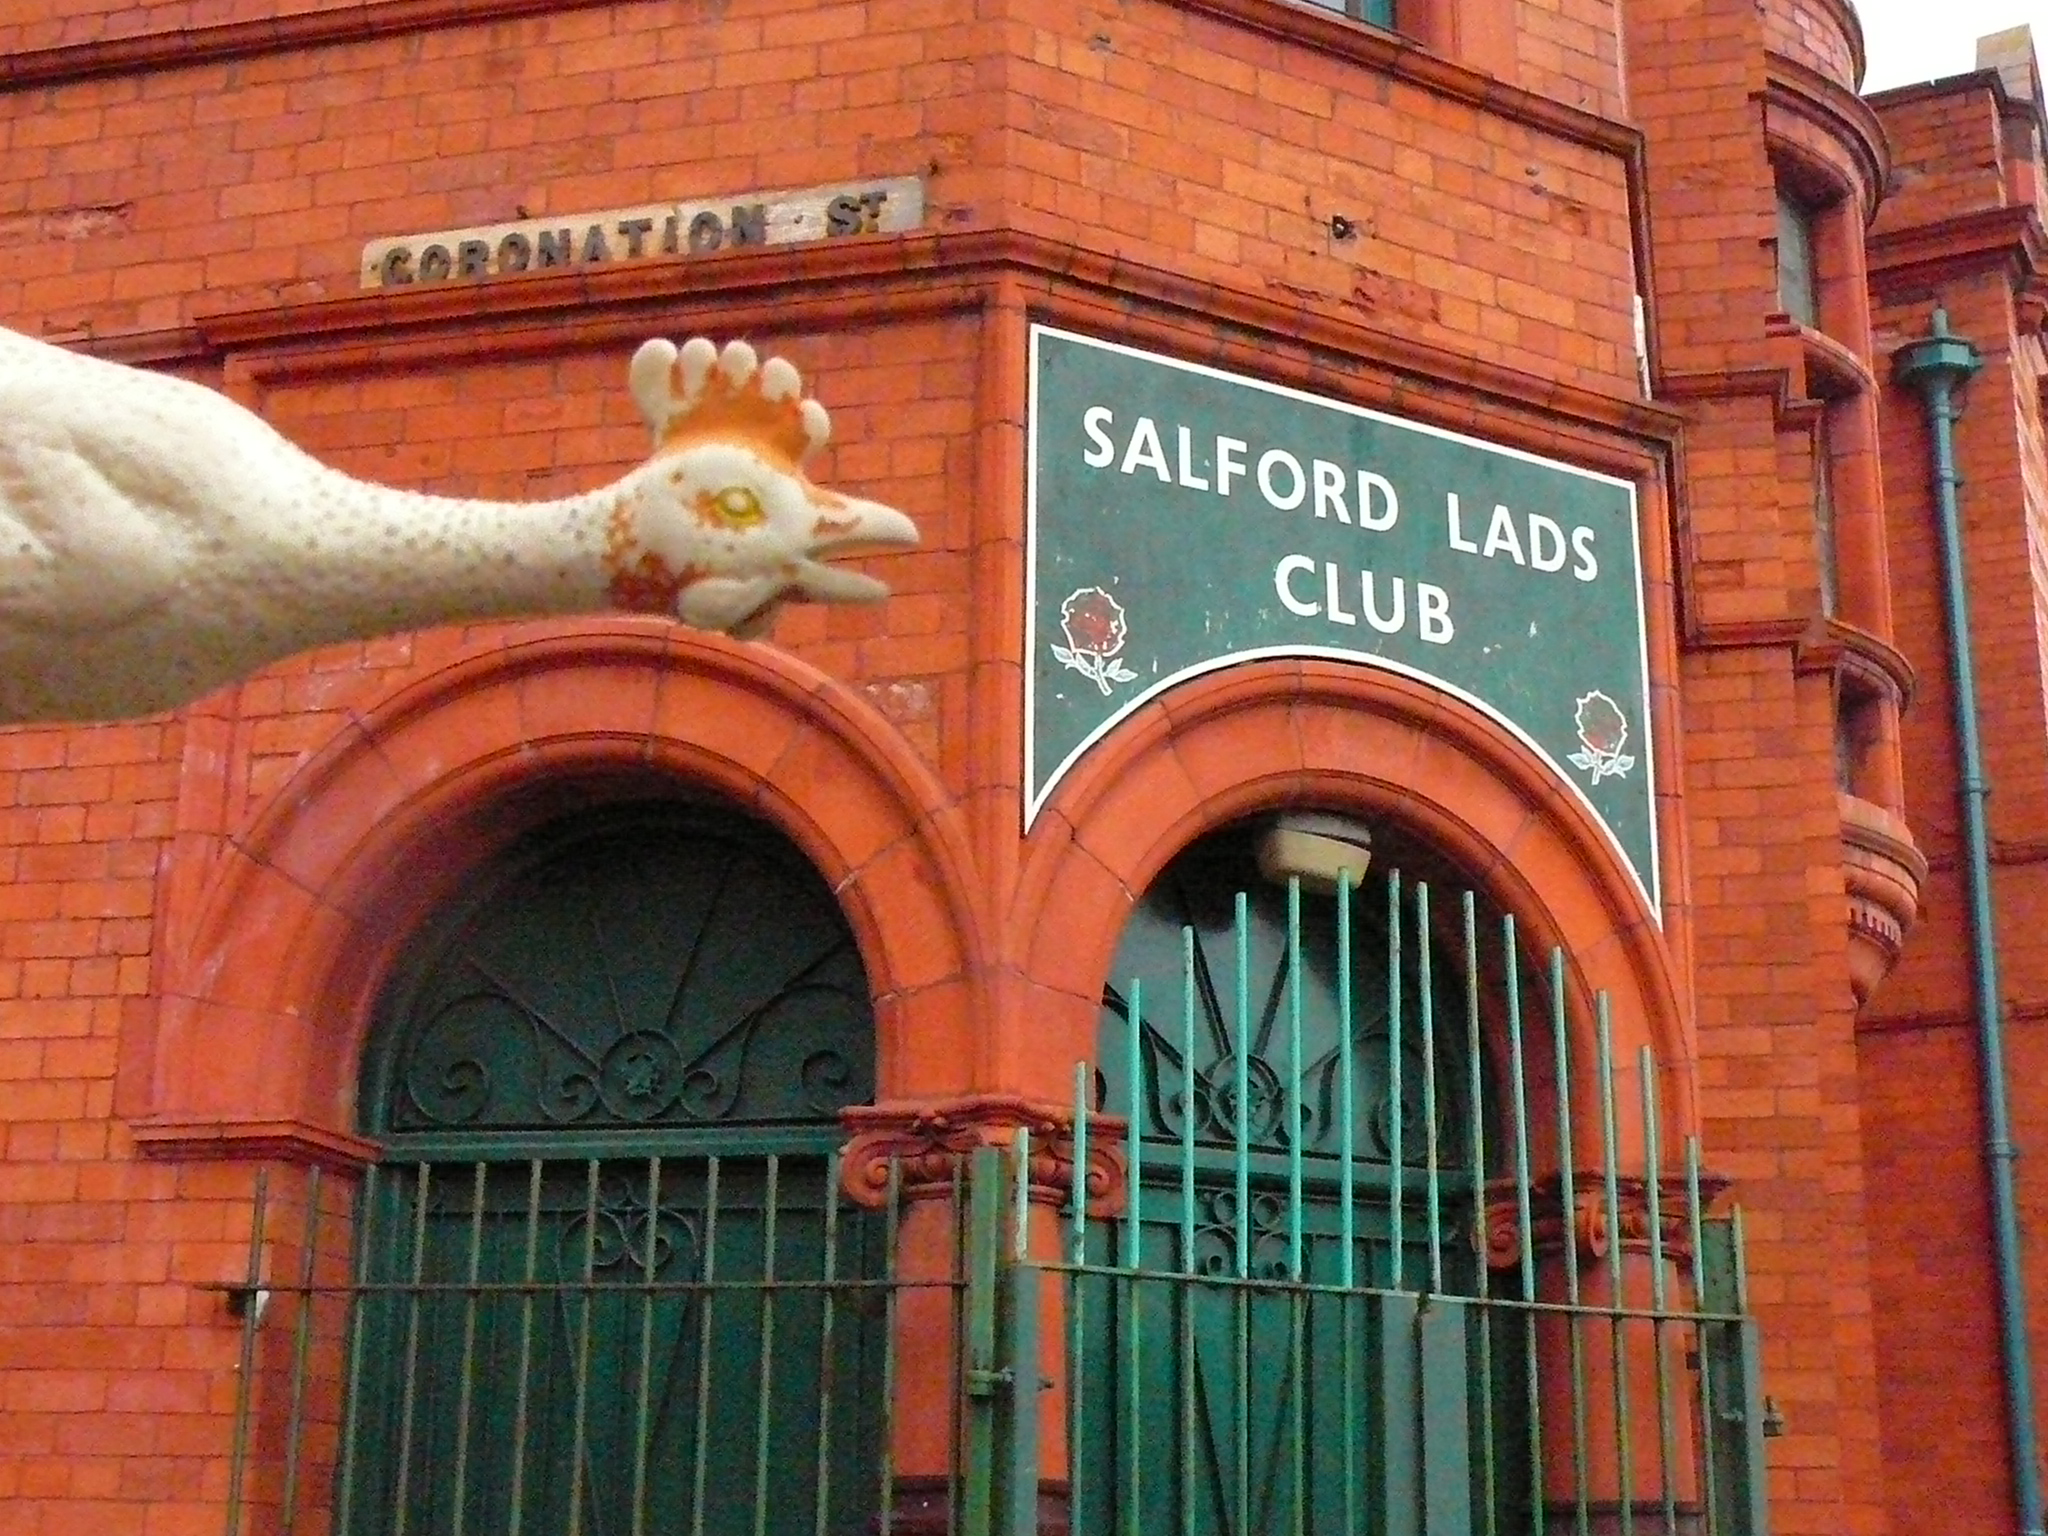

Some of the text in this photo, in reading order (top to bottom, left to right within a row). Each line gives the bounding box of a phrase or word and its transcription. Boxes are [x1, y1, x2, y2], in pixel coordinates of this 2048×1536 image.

[381, 192, 888, 285] CORONATION ST
[1083, 406, 1599, 582] SALFORD LADS
[1274, 554, 1455, 644] CLUB
